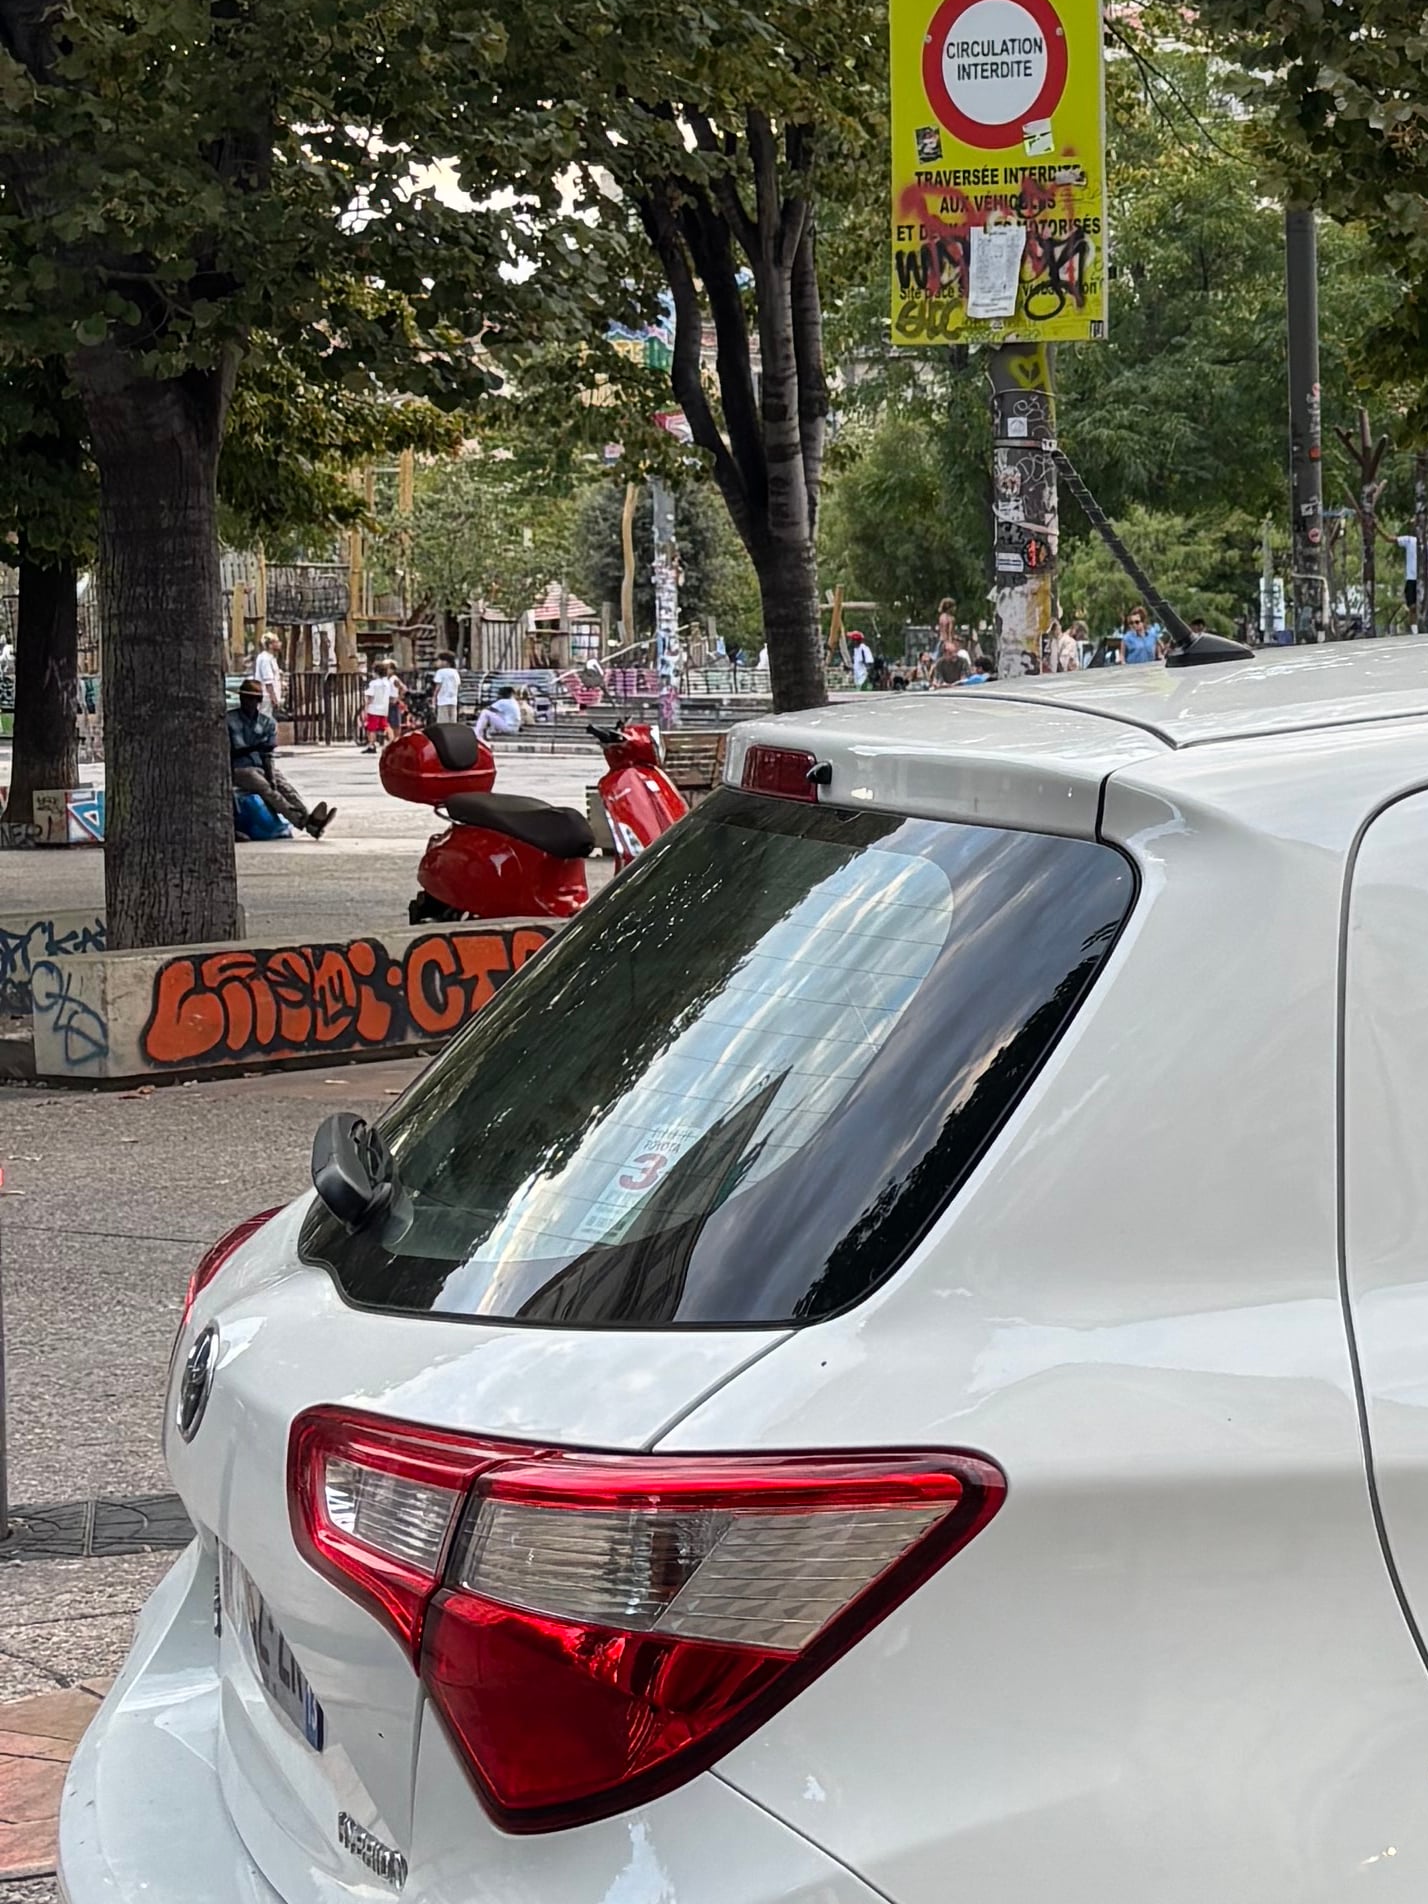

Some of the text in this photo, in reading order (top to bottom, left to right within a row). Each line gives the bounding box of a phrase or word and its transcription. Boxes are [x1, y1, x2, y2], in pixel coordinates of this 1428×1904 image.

[946, 37, 1043, 59] CIRCULATION
[957, 60, 1033, 81] INTERDITE
[915, 165, 999, 187] TRAVERSÉE
